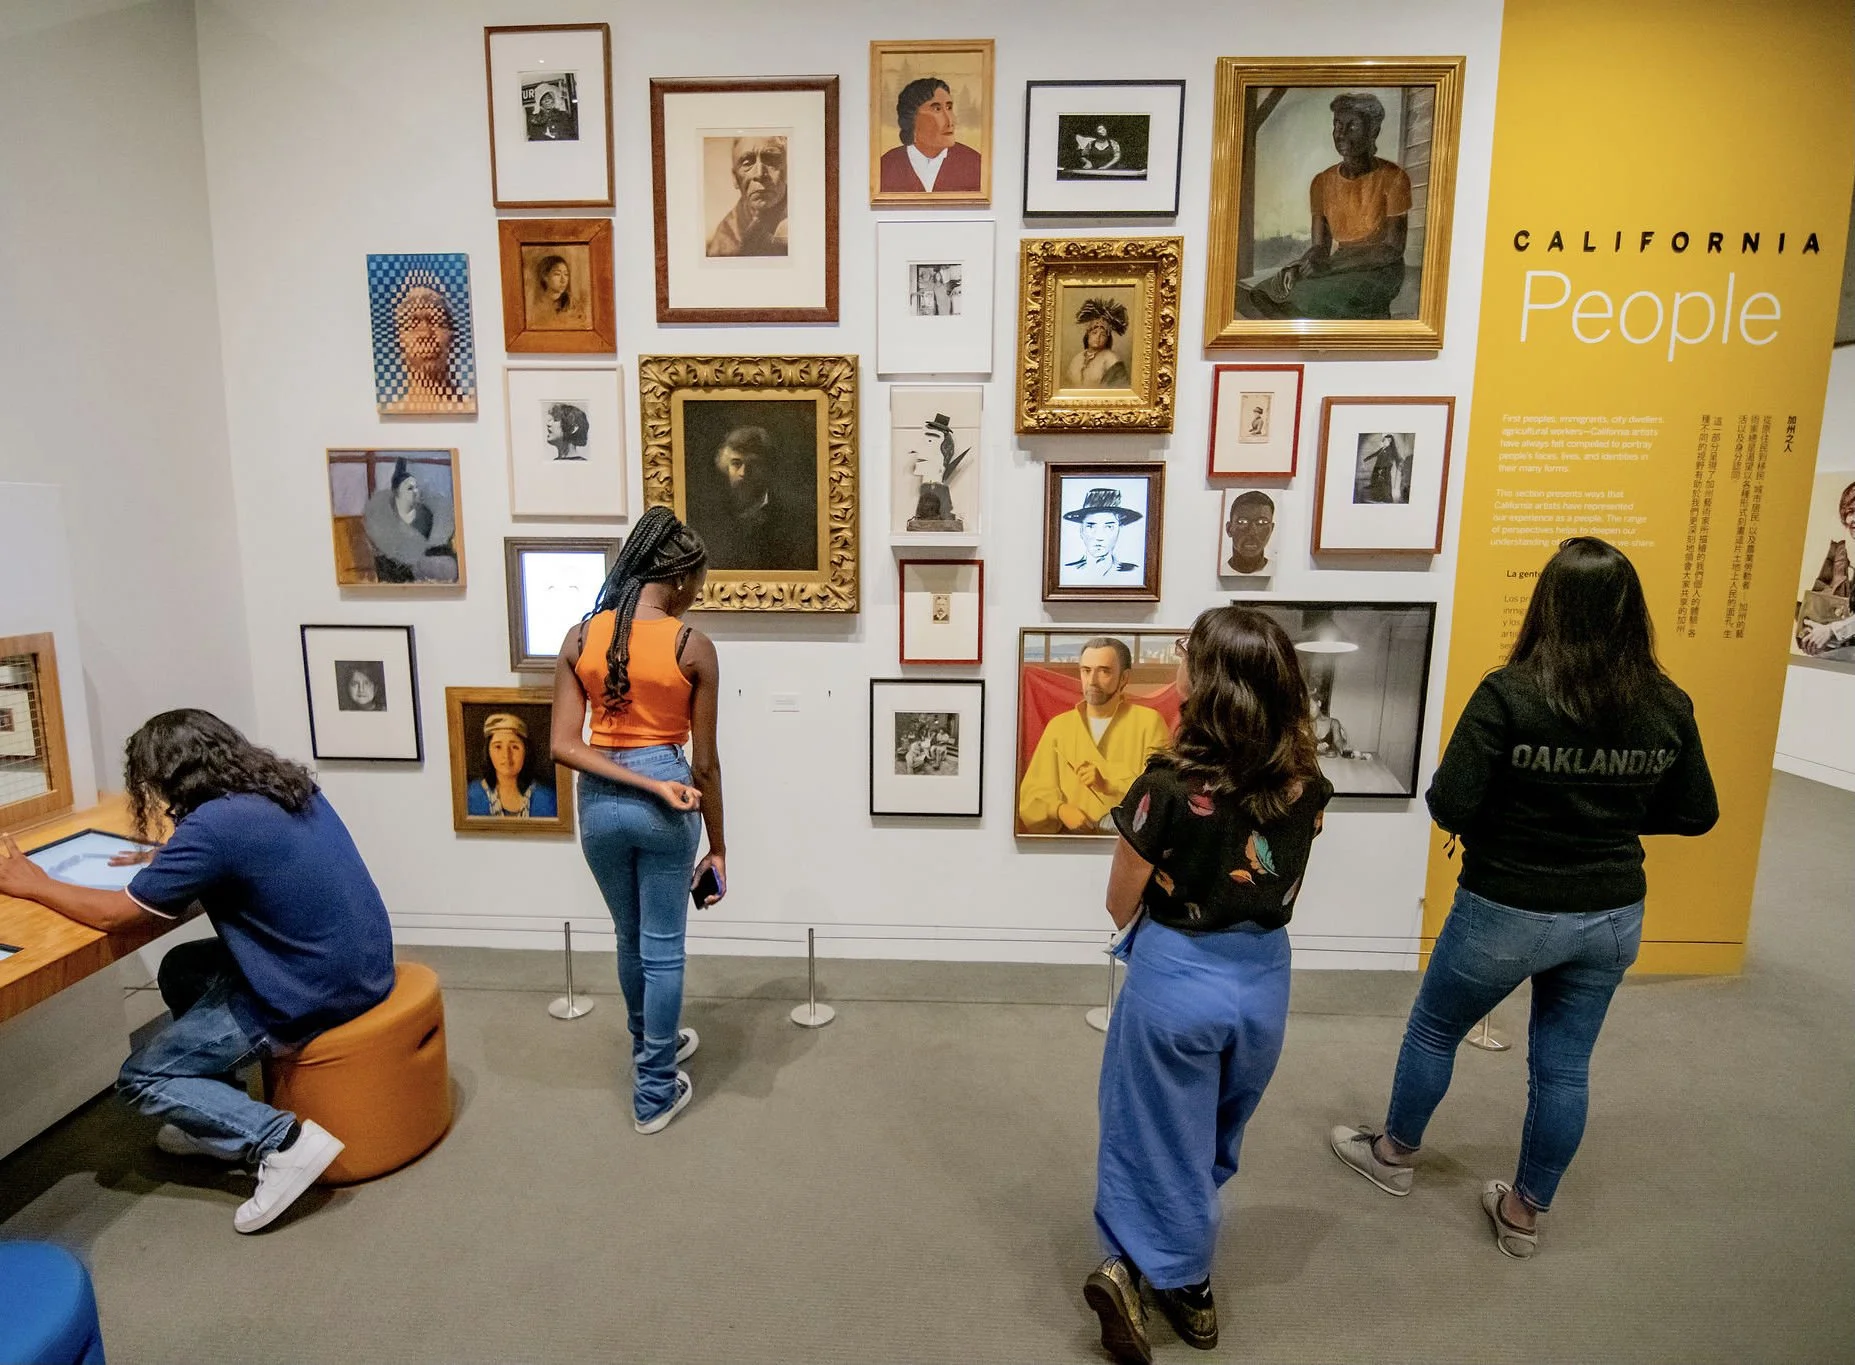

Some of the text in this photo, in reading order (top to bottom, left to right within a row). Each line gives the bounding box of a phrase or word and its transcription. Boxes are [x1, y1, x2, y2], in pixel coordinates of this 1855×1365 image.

[1513, 230, 1820, 254] CALIFORNIA
[1520, 270, 1781, 362] People
[1502, 414, 1521, 423] First
[1611, 415, 1627, 425] city
[1502, 427, 1548, 437] agricultural
[1632, 428, 1658, 436] artists
[1784, 415, 1797, 453] 加州之人
[1500, 440, 1652, 450] have always felt compelled to portray
[1584, 452, 1599, 461] and
[1601, 452, 1639, 461] identities
[1641, 453, 1649, 461] in
[1499, 464, 1517, 473] their
[1519, 465, 1541, 474] many
[1496, 489, 1624, 499] This section presents ways that
[1494, 501, 1634, 512] California artists have represented
[1493, 514, 1507, 522] our
[1509, 514, 1553, 523] experience
[1606, 514, 1622, 523] The
[1623, 515, 1647, 524] range
[1491, 526, 1501, 534] of
[1502, 526, 1553, 536] perspectives
[1555, 526, 1578, 536] helps
[1579, 527, 1588, 535] to
[1590, 527, 1620, 536] deepen
[1490, 538, 1550, 548] understanding
[1504, 595, 1519, 603] Los
